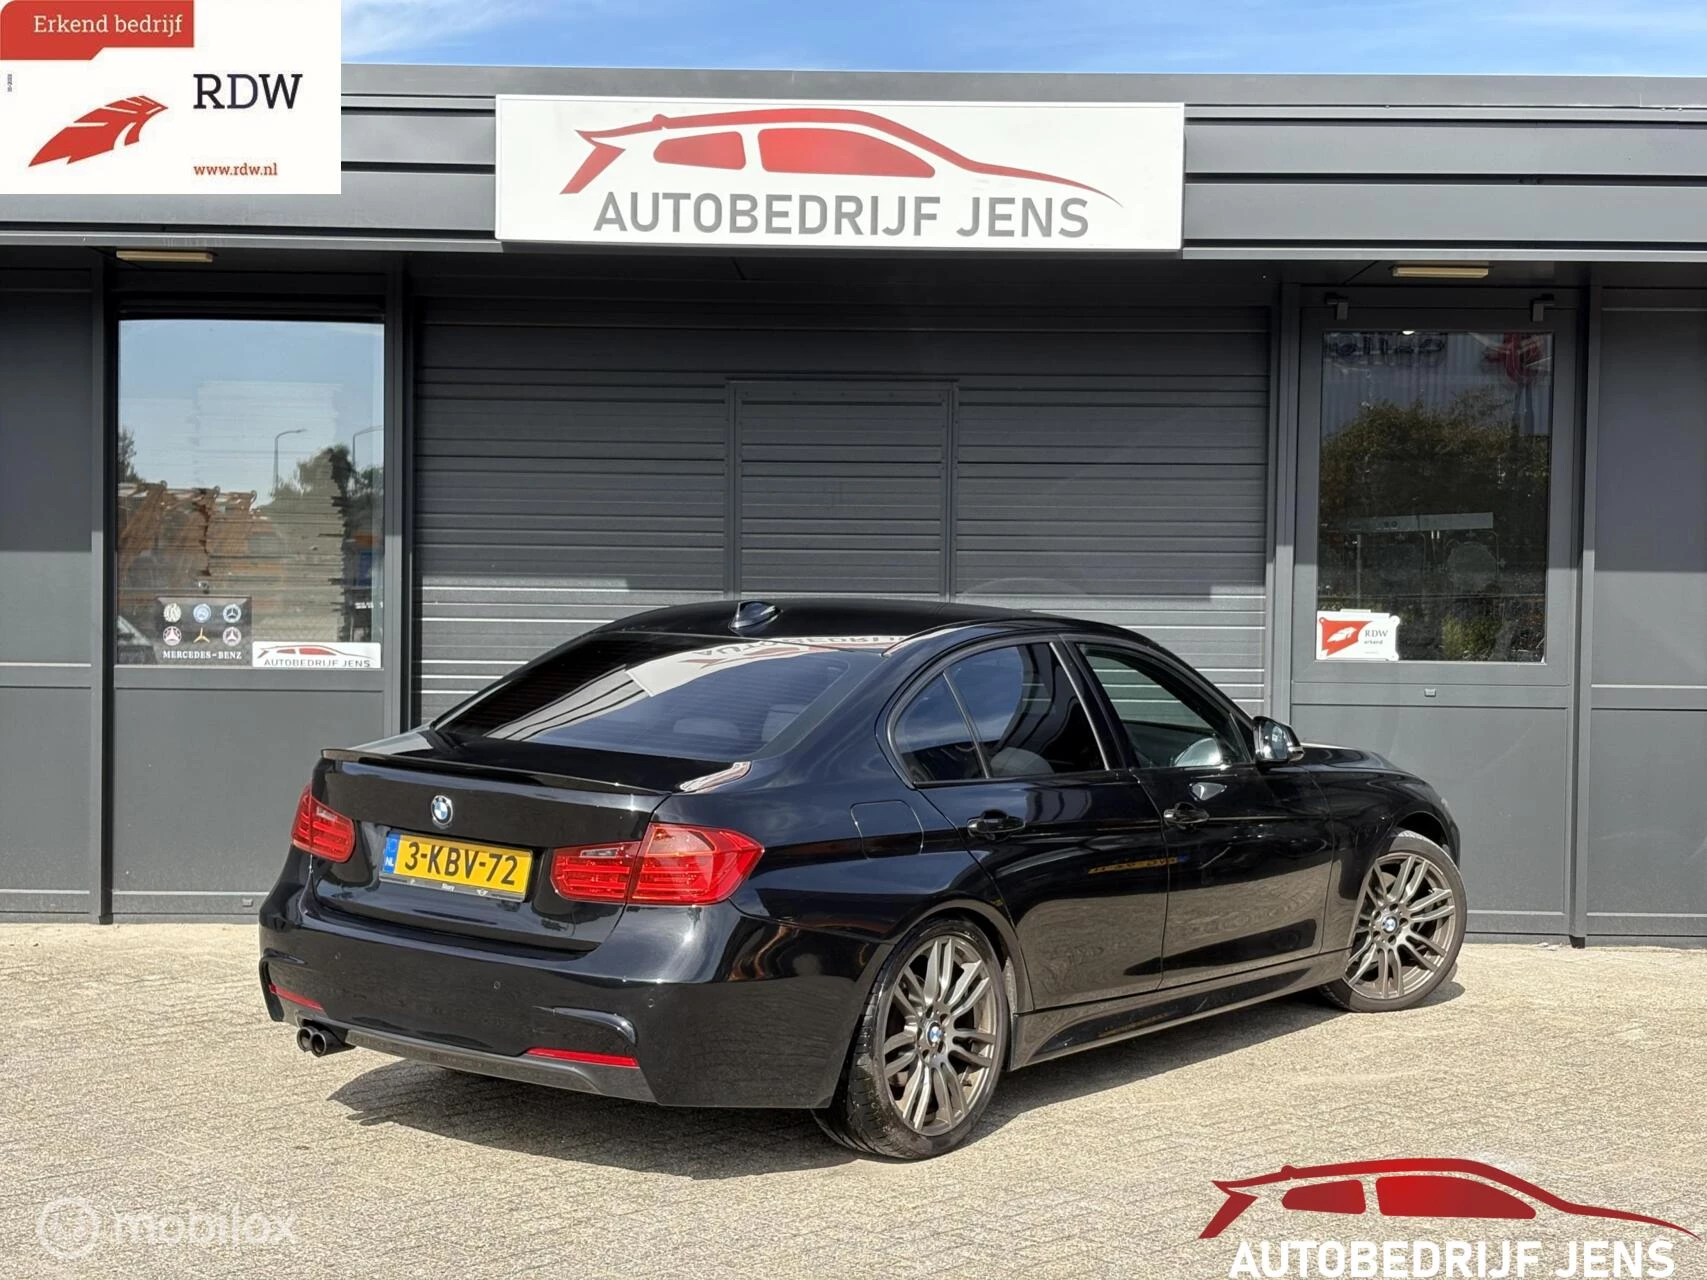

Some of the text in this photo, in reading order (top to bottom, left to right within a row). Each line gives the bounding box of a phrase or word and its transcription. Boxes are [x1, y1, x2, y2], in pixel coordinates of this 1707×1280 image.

[594, 192, 1089, 238] AUTOBEDRIJF JENS
[1364, 629, 1389, 637] RDW
[264, 659, 338, 667] AUTOBEDRIJF
[384, 856, 395, 866] NL
[404, 841, 519, 886] 3-KBV-72
